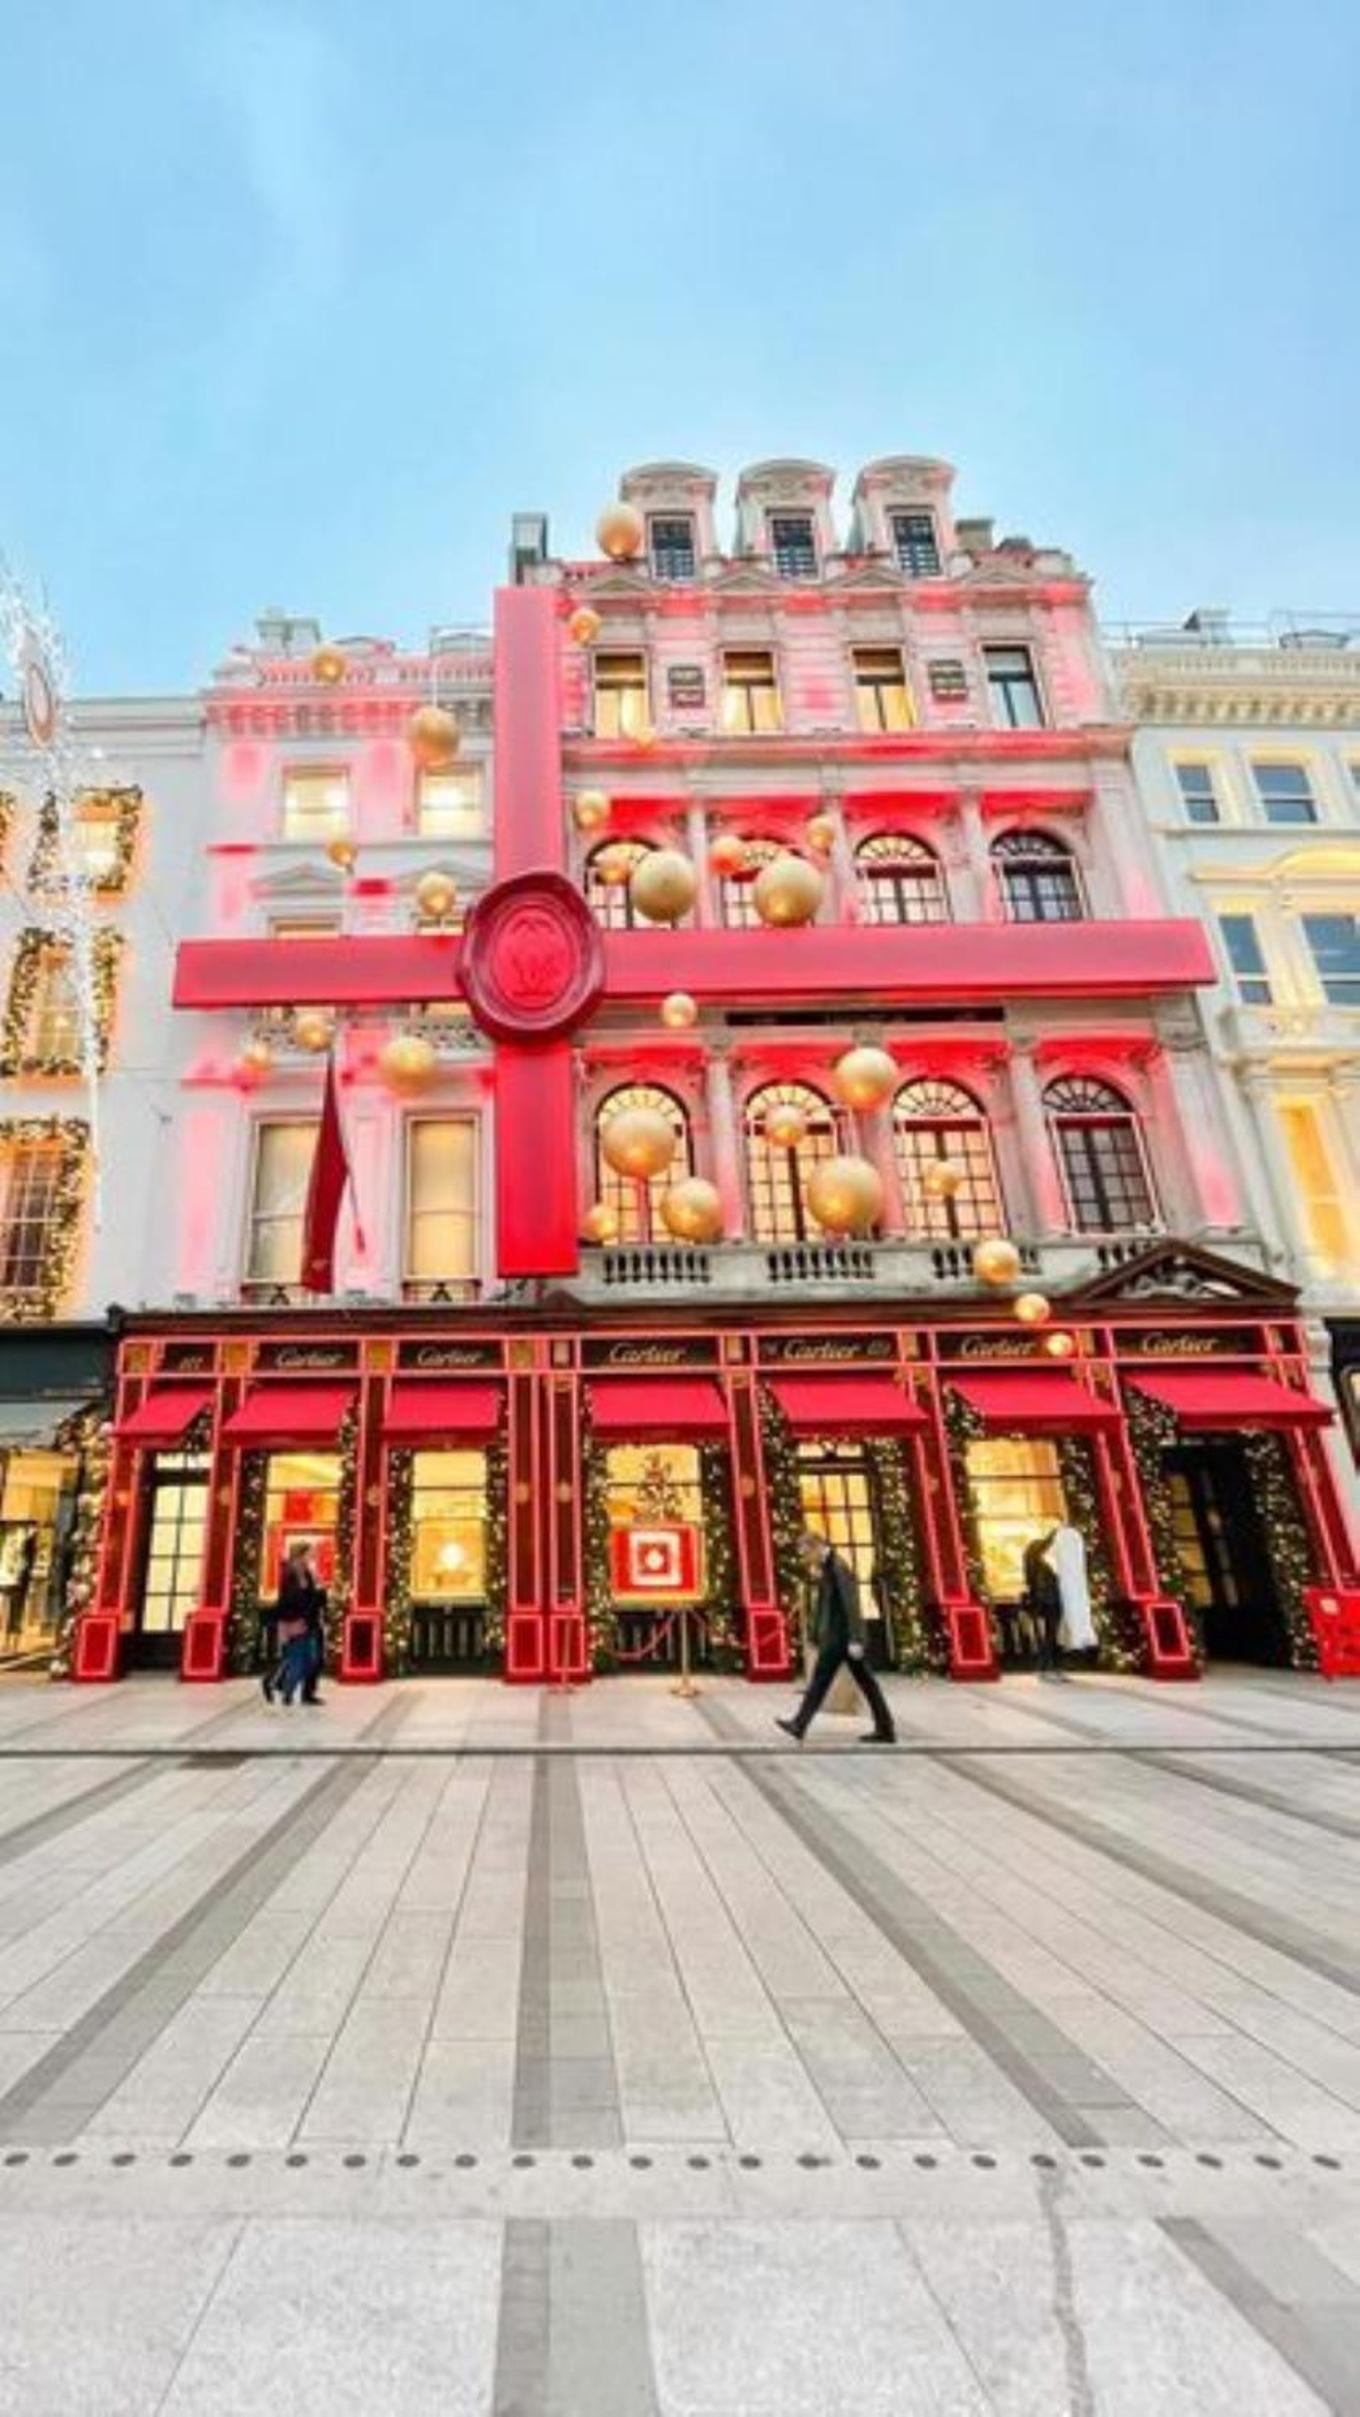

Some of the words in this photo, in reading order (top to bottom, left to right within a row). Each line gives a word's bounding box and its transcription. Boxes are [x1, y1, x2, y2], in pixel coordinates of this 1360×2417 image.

[783, 1339, 861, 1360] Cartier
[960, 1335, 1036, 1356] Cartier
[1140, 1331, 1219, 1352] Cartier
[276, 1346, 344, 1367] Cartier
[417, 1345, 484, 1366] Cartier
[608, 1342, 687, 1363] Cartier
